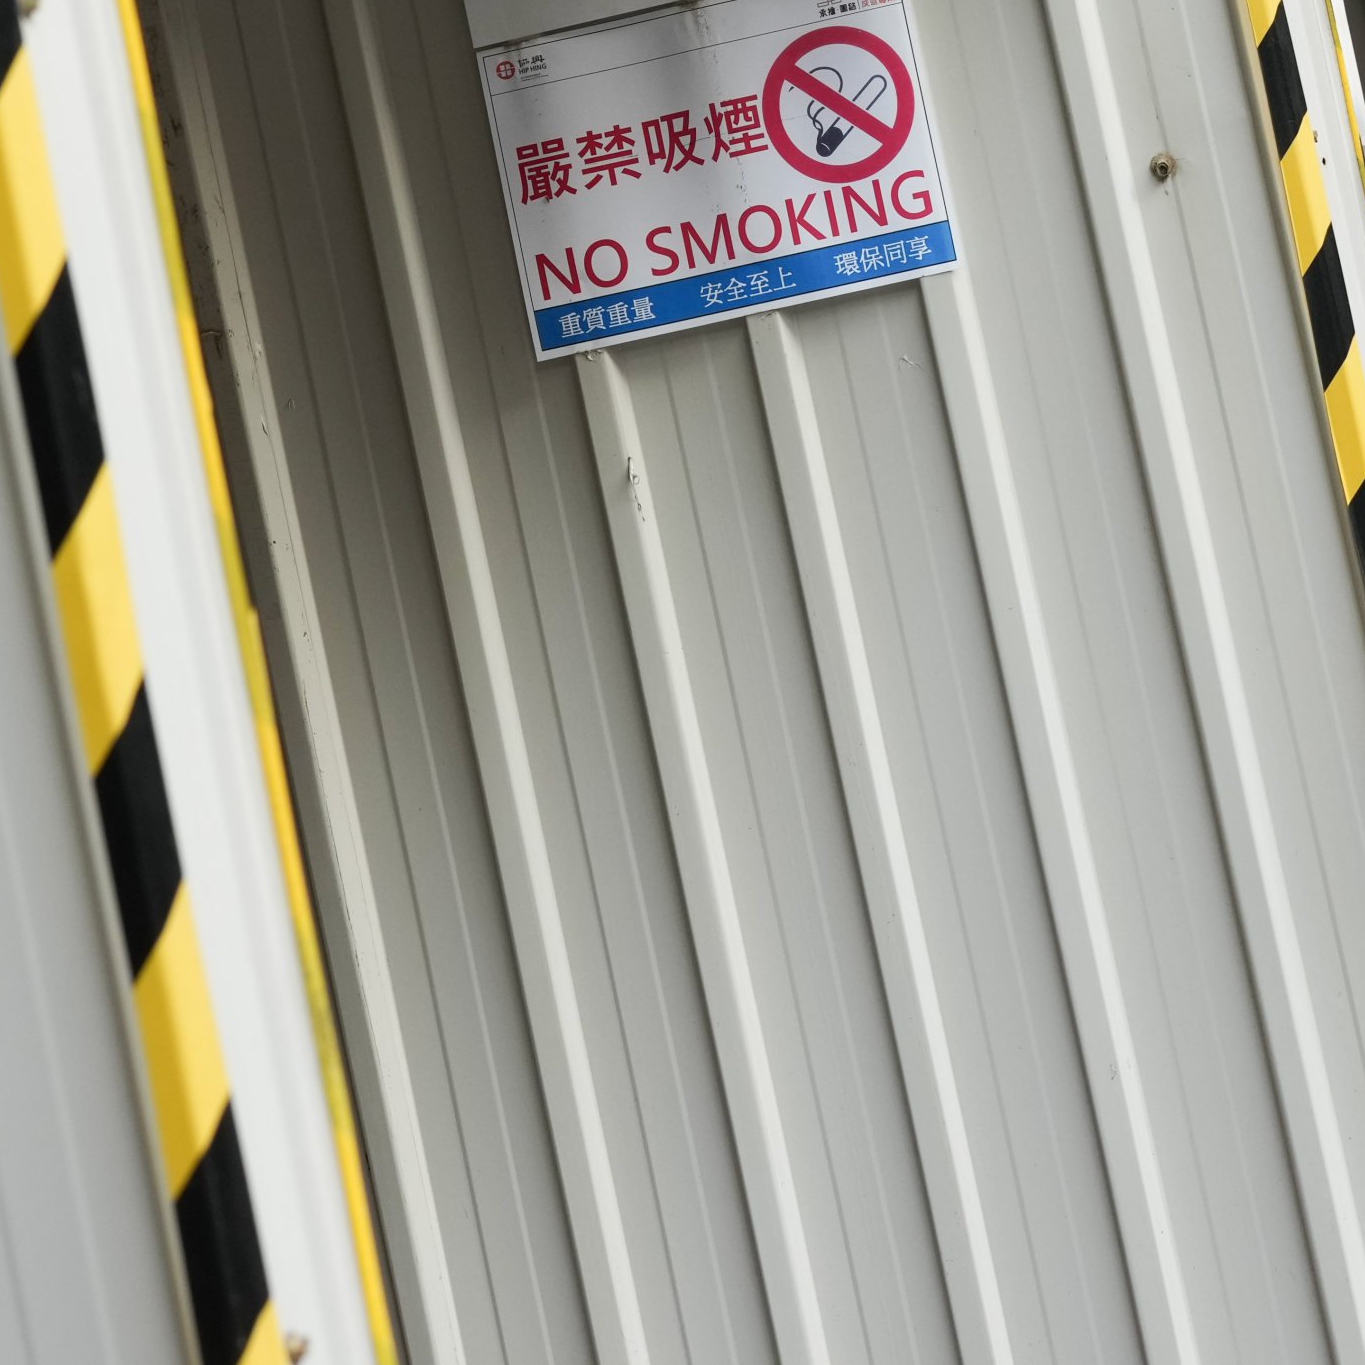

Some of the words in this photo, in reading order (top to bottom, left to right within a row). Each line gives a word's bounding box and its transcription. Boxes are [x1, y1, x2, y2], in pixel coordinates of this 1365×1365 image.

[518, 67, 531, 75] HIP
[530, 63, 547, 73] HING
[515, 94, 769, 206] 嚴禁吸煙
[534, 238, 629, 301] NO
[645, 169, 934, 277] SMOKING
[558, 296, 657, 338] 重質重量
[699, 266, 797, 308] 安全至上
[833, 235, 933, 277] 環保同享
